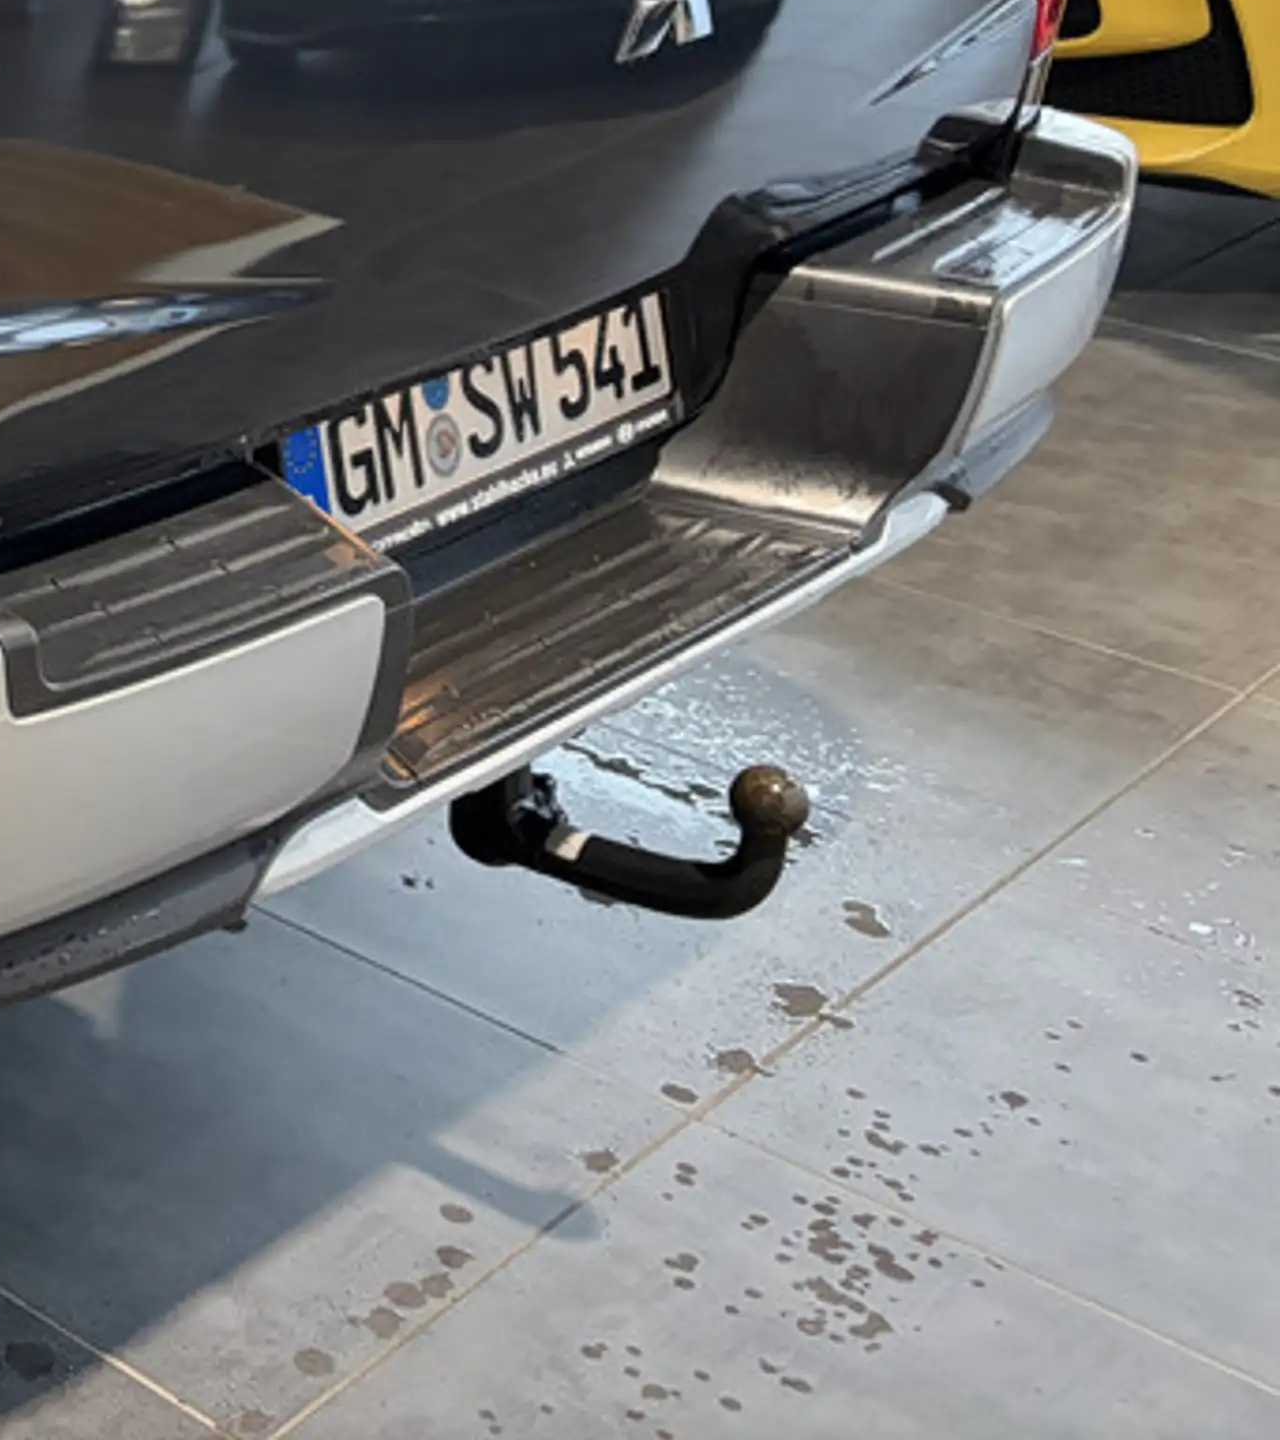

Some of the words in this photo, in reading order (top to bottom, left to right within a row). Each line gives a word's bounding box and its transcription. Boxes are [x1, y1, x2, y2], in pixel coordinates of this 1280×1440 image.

[329, 386, 425, 516] GM
[461, 343, 542, 459] SW
[551, 297, 662, 421] 541
